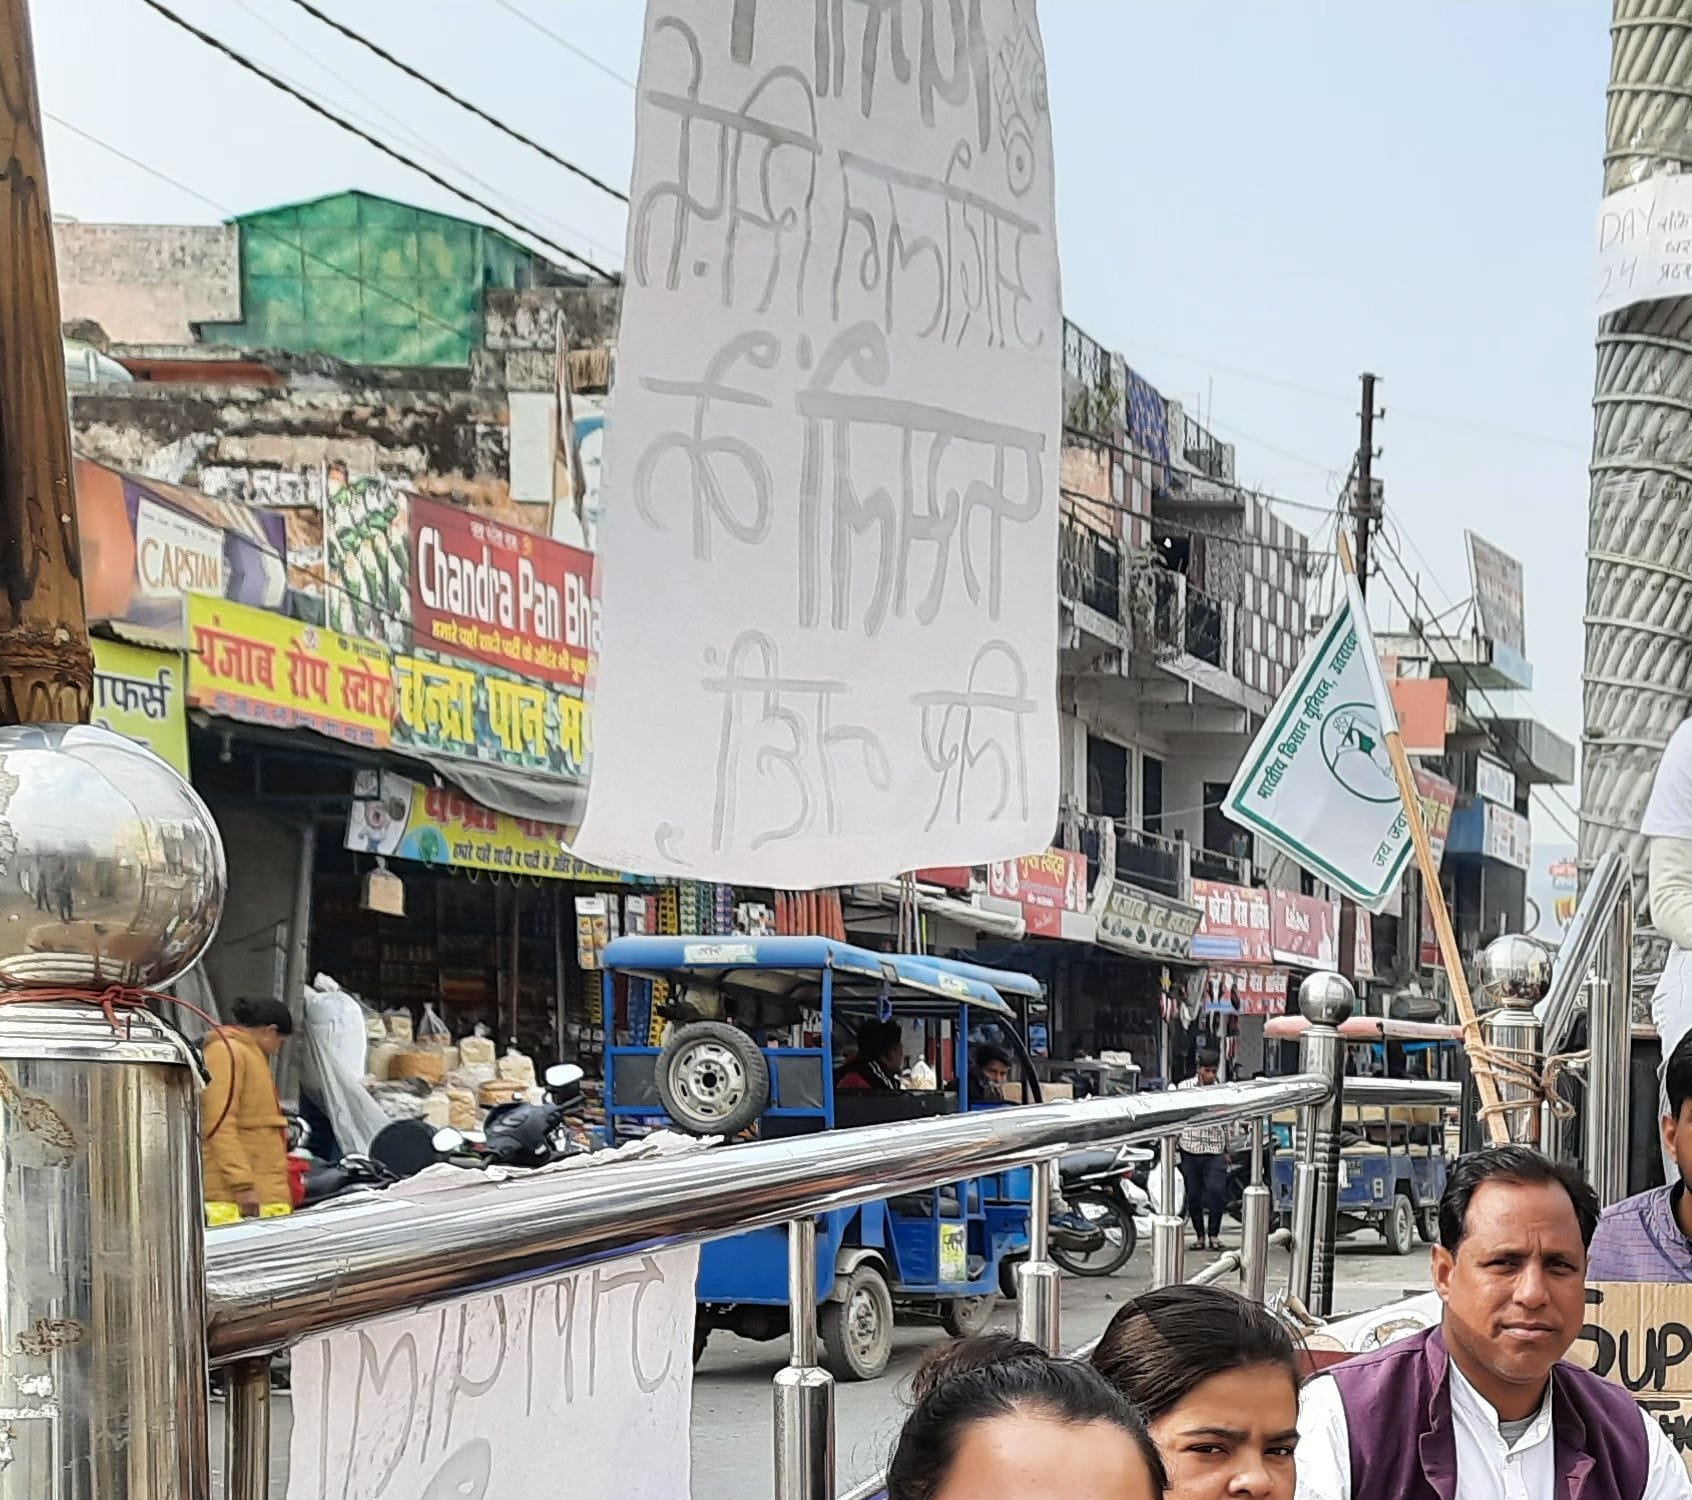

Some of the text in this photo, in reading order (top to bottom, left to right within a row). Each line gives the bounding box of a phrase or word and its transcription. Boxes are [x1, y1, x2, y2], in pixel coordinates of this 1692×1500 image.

[140, 536, 219, 590] CAPSTAN
[418, 526, 514, 630] Chandra
[517, 557, 562, 642] Pan
[194, 615, 276, 691] पंजाब
[485, 674, 547, 757] पान
[1255, 754, 1290, 801] भारतीय
[1285, 718, 1313, 762] किसान
